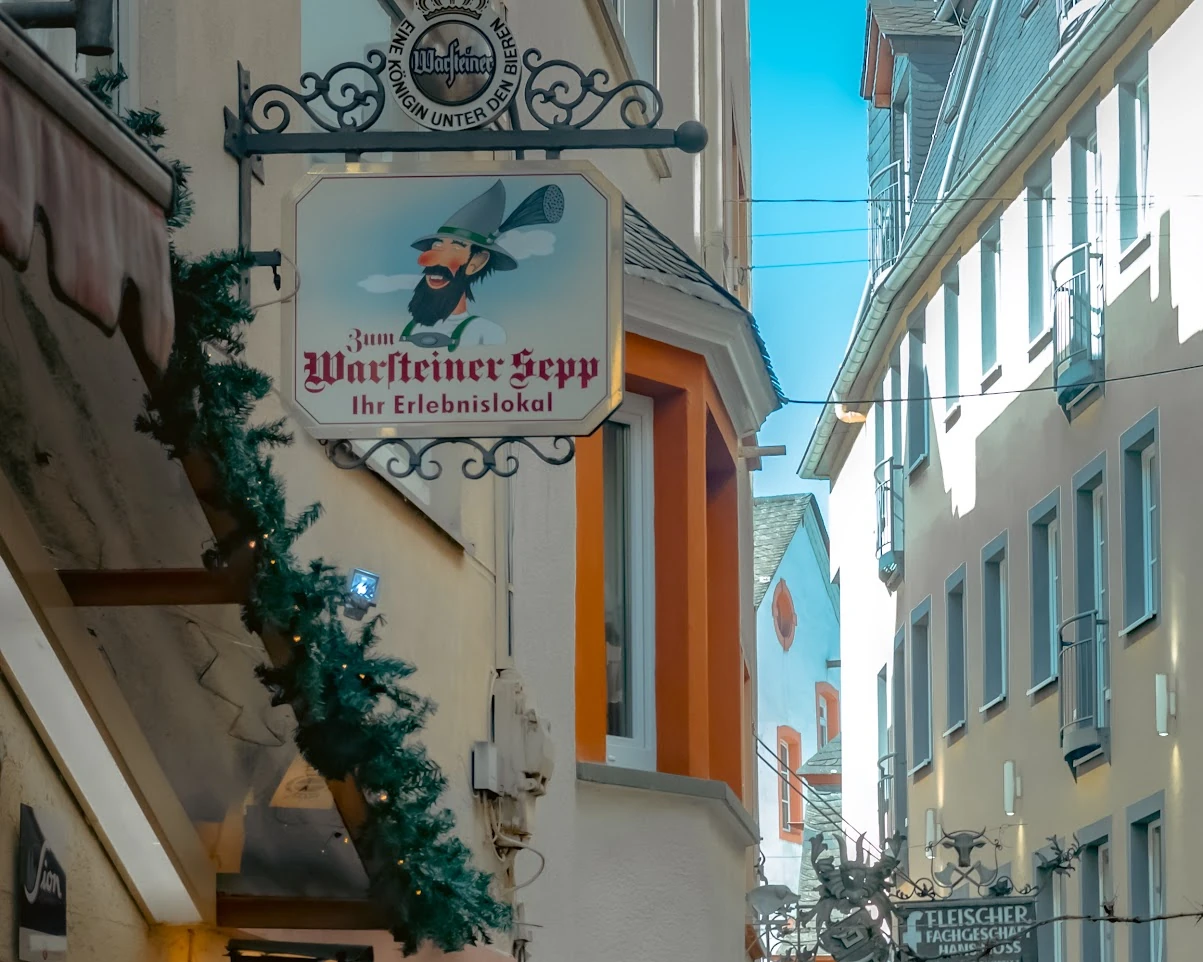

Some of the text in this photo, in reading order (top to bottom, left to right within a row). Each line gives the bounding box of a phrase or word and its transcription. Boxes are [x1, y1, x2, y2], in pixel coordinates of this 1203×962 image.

[388, 17, 519, 128] EINE KÖNIGIN UNTER DEN BIEREN
[346, 328, 394, 353] Zum
[510, 347, 600, 390] Sepp
[352, 392, 553, 415] Ihr Erlebnislokal
[980, 941, 1022, 956] OSS
